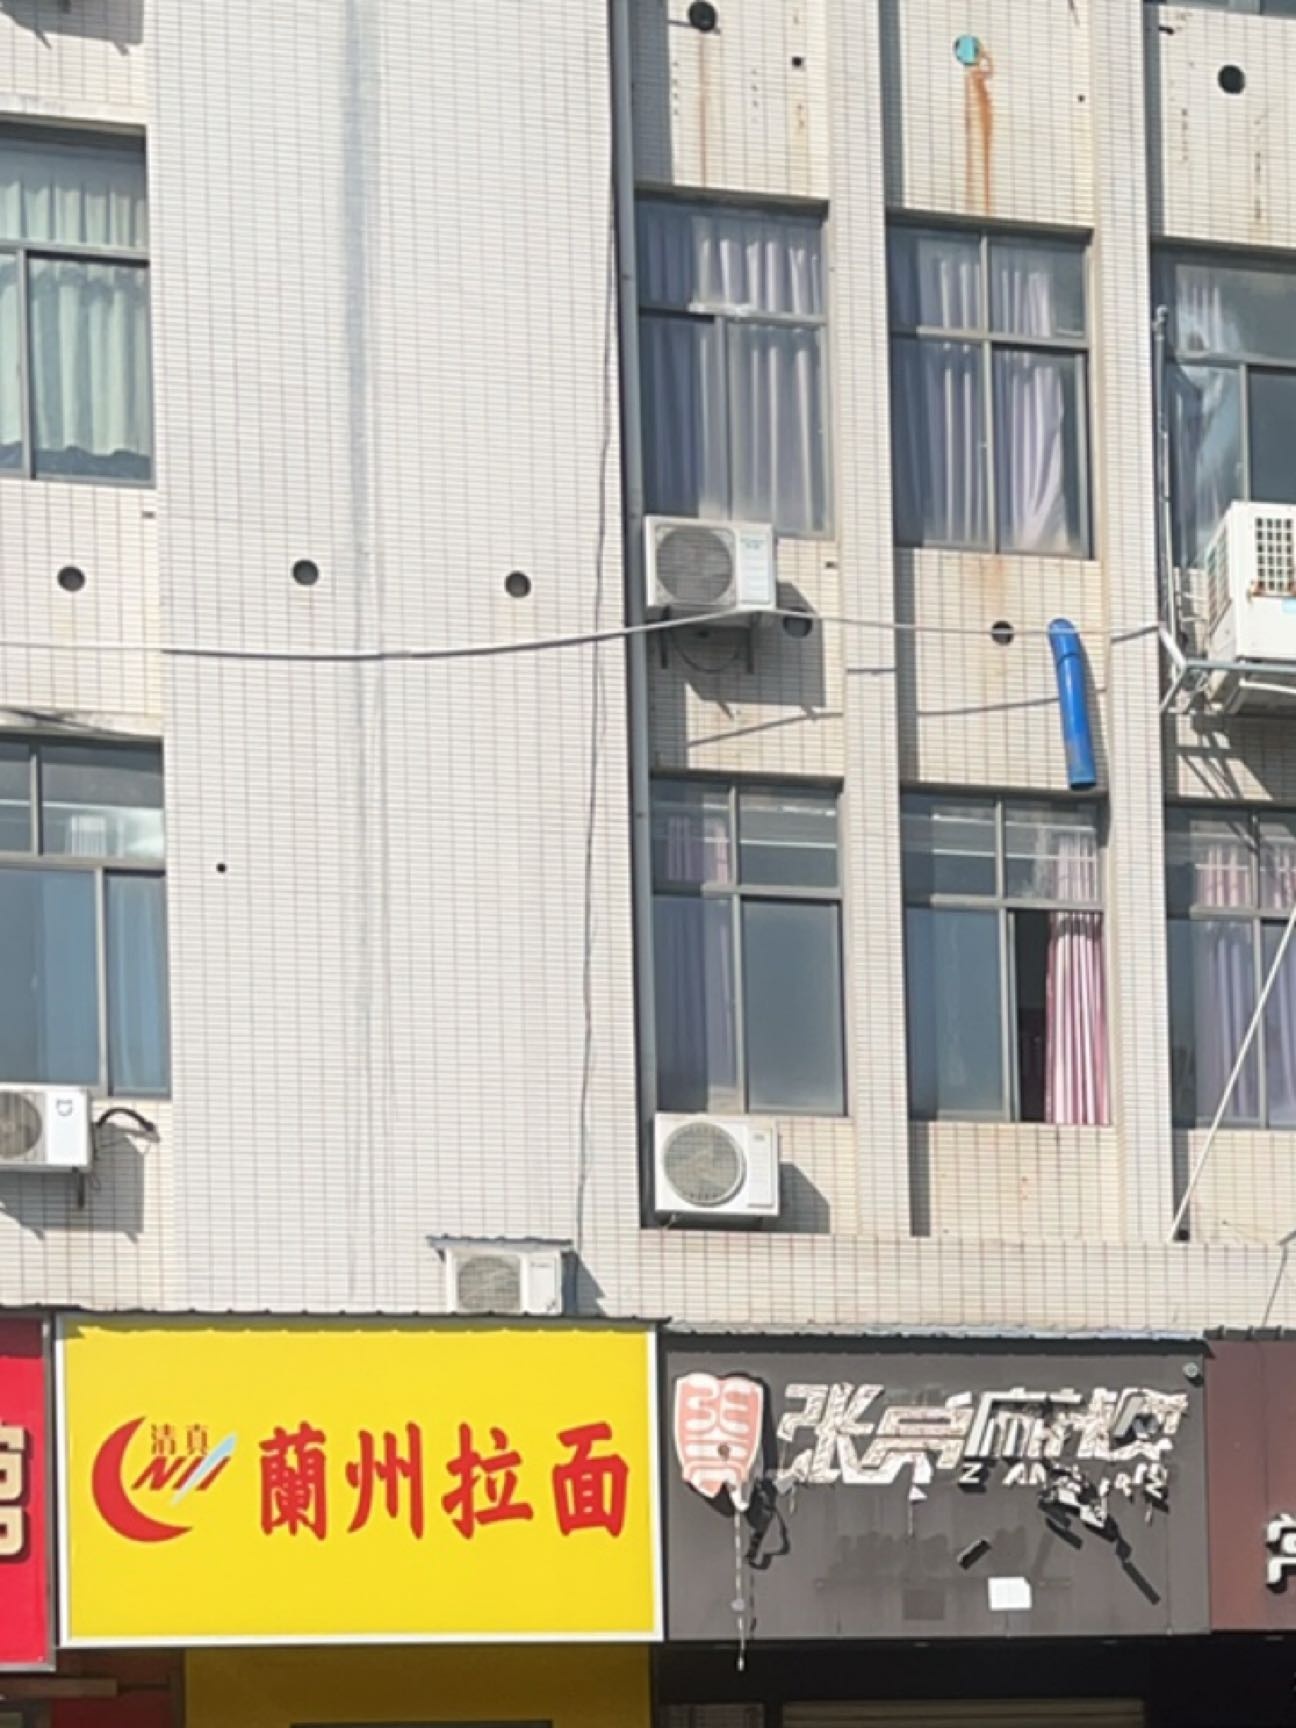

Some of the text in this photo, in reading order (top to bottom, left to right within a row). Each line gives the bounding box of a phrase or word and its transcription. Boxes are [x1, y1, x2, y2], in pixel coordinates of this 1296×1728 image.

[150, 1423, 208, 1455] 清真
[258, 1420, 630, 1541] 蘭州拉面
